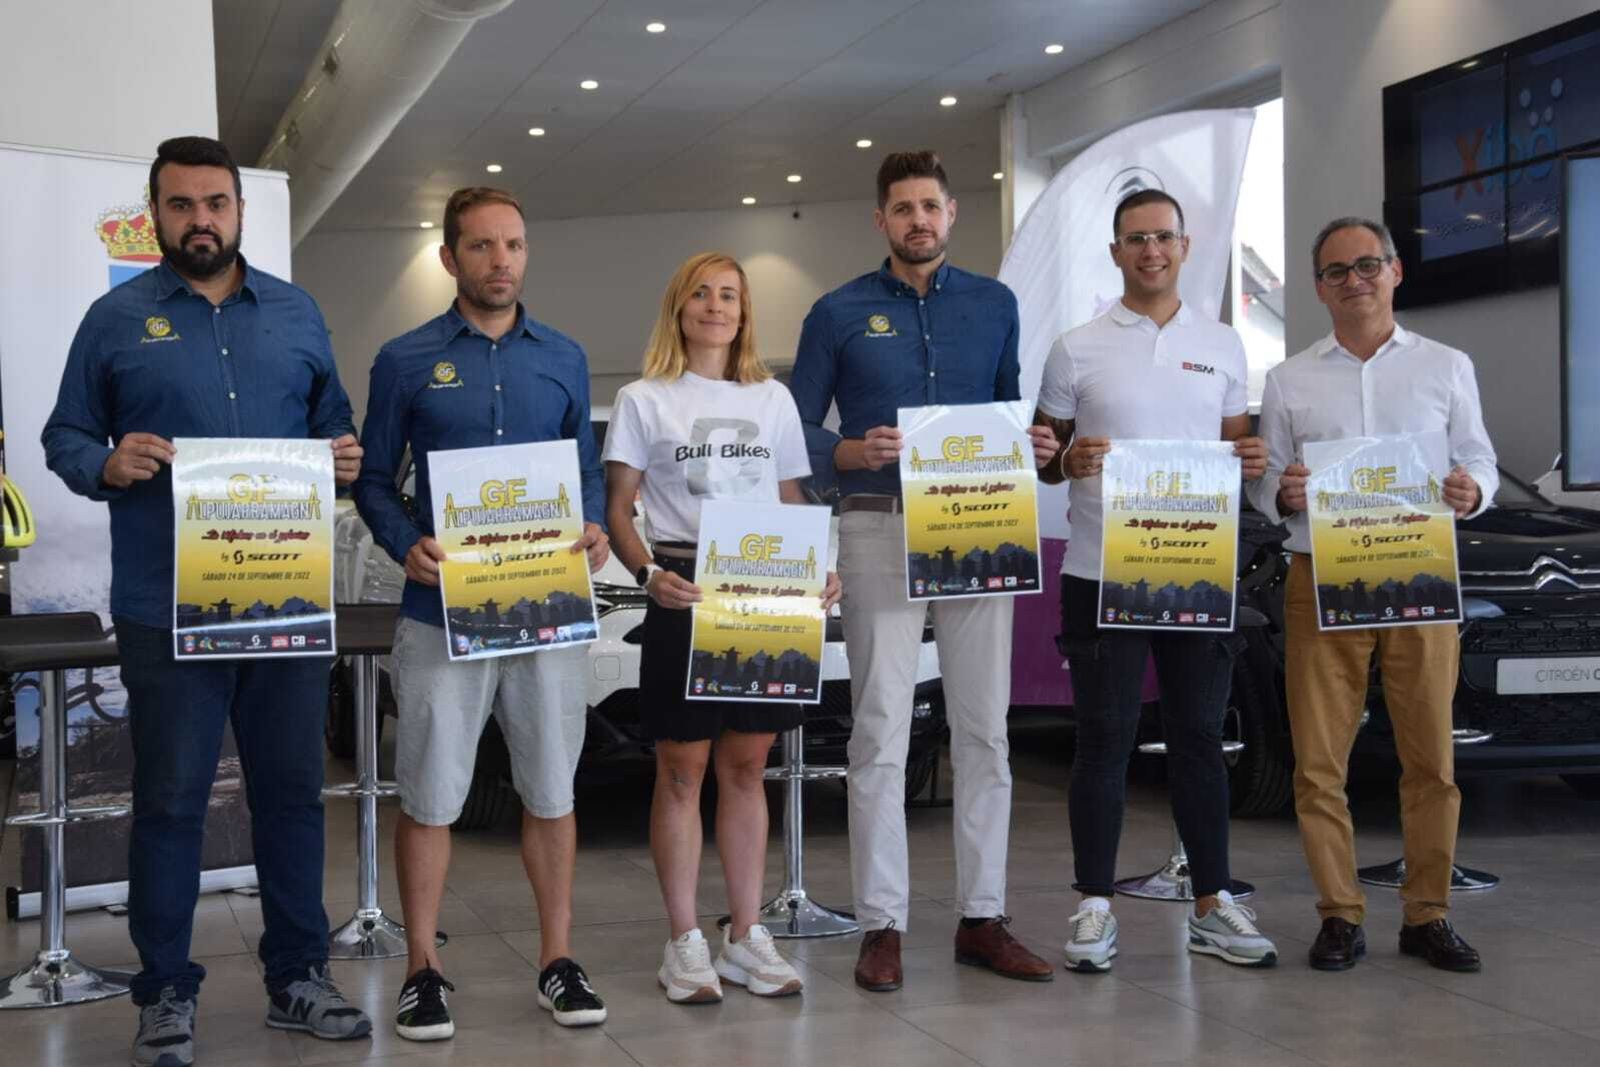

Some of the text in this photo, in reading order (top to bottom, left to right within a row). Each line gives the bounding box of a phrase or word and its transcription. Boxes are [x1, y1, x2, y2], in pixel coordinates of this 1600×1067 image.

[1182, 361, 1215, 375] BSM
[675, 444, 771, 462] Bull Bikes
[941, 435, 984, 461] GF
[1352, 466, 1397, 493] GF
[480, 478, 527, 509] GF
[963, 503, 1010, 511] SCOTT
[1374, 534, 1425, 543] SCOTT
[740, 533, 783, 560] GF
[1162, 540, 1209, 548] SCOTT
[246, 553, 303, 561] SCOTT
[505, 551, 556, 561] SCOTT
[202, 572, 225, 581] SÁBADO
[227, 572, 236, 581] 24
[237, 572, 245, 581] DE
[247, 572, 283, 581] SEPTIEMBRE
[284, 572, 292, 580] DE
[499, 574, 506, 582] DE
